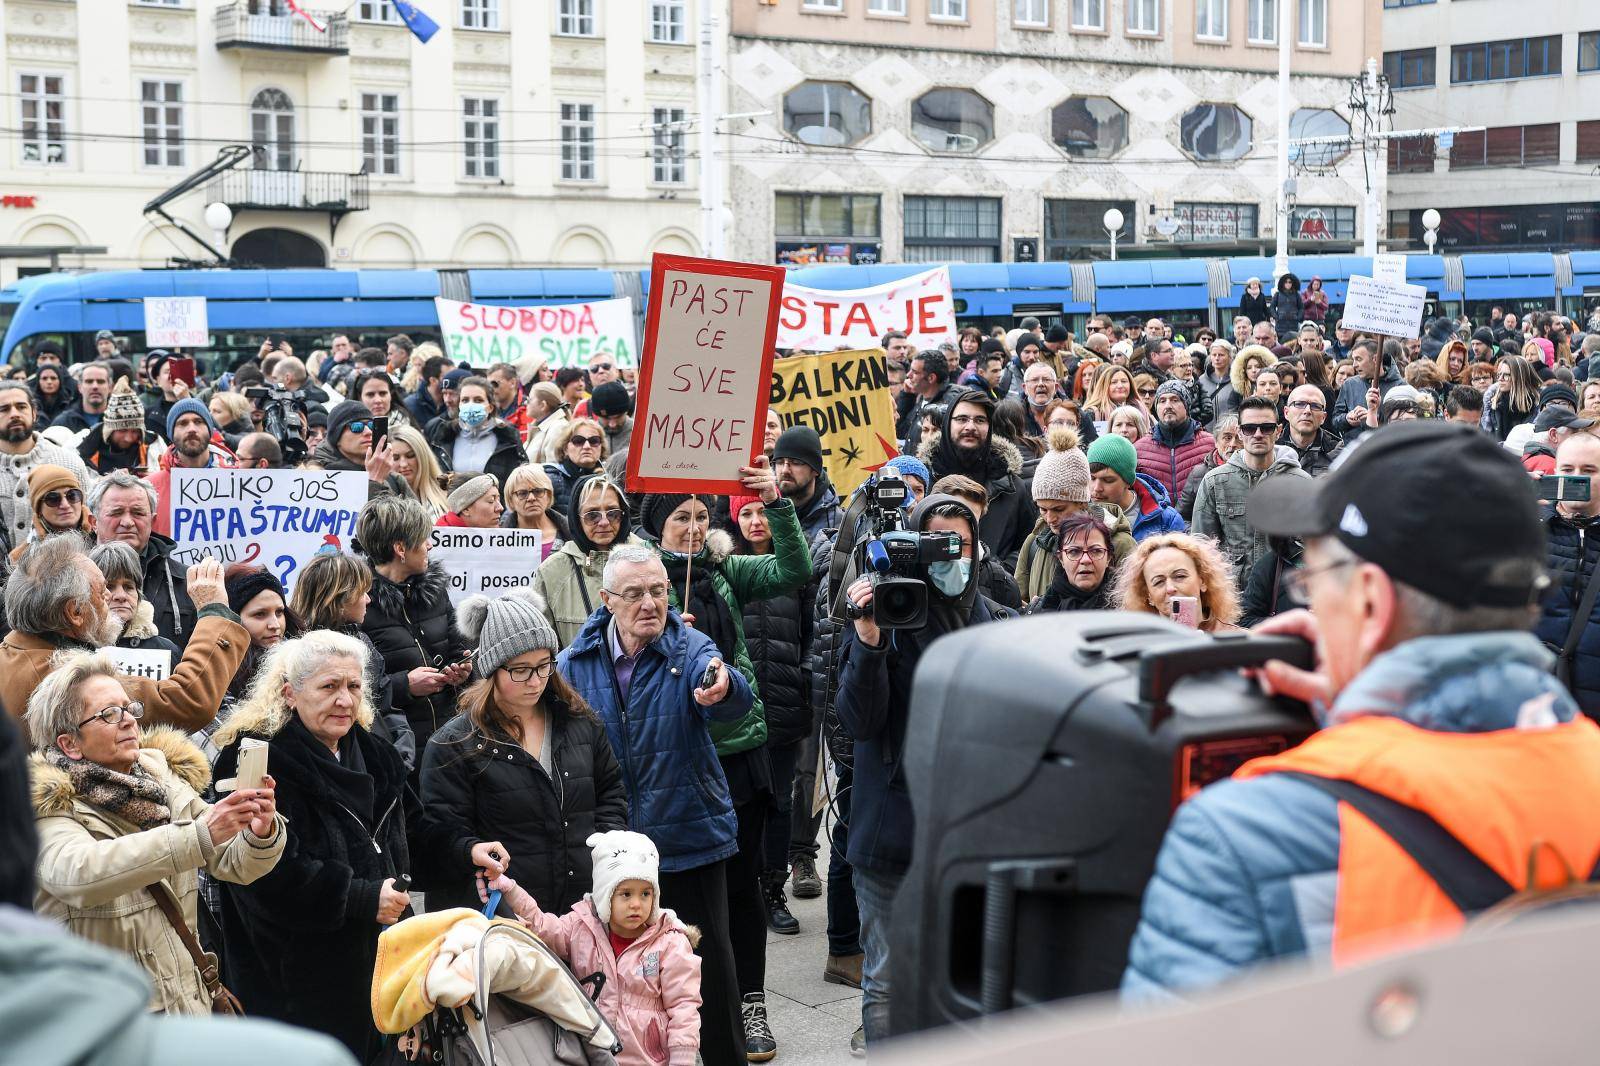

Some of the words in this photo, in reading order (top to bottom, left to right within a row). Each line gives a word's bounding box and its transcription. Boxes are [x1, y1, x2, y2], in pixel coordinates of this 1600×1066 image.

[1179, 224, 1207, 235] STEAK
[1181, 208, 1242, 222] AMERICAN
[670, 279, 753, 316] PAST
[460, 304, 598, 335] SLOBODA
[696, 320, 726, 349] ĆE
[668, 364, 736, 394] SVE
[769, 356, 889, 404] BALKAN
[648, 413, 745, 451] MASKE
[290, 472, 341, 502] JOŠ
[430, 530, 484, 548] Samo
[489, 531, 535, 547] radim
[449, 571, 467, 591] oj
